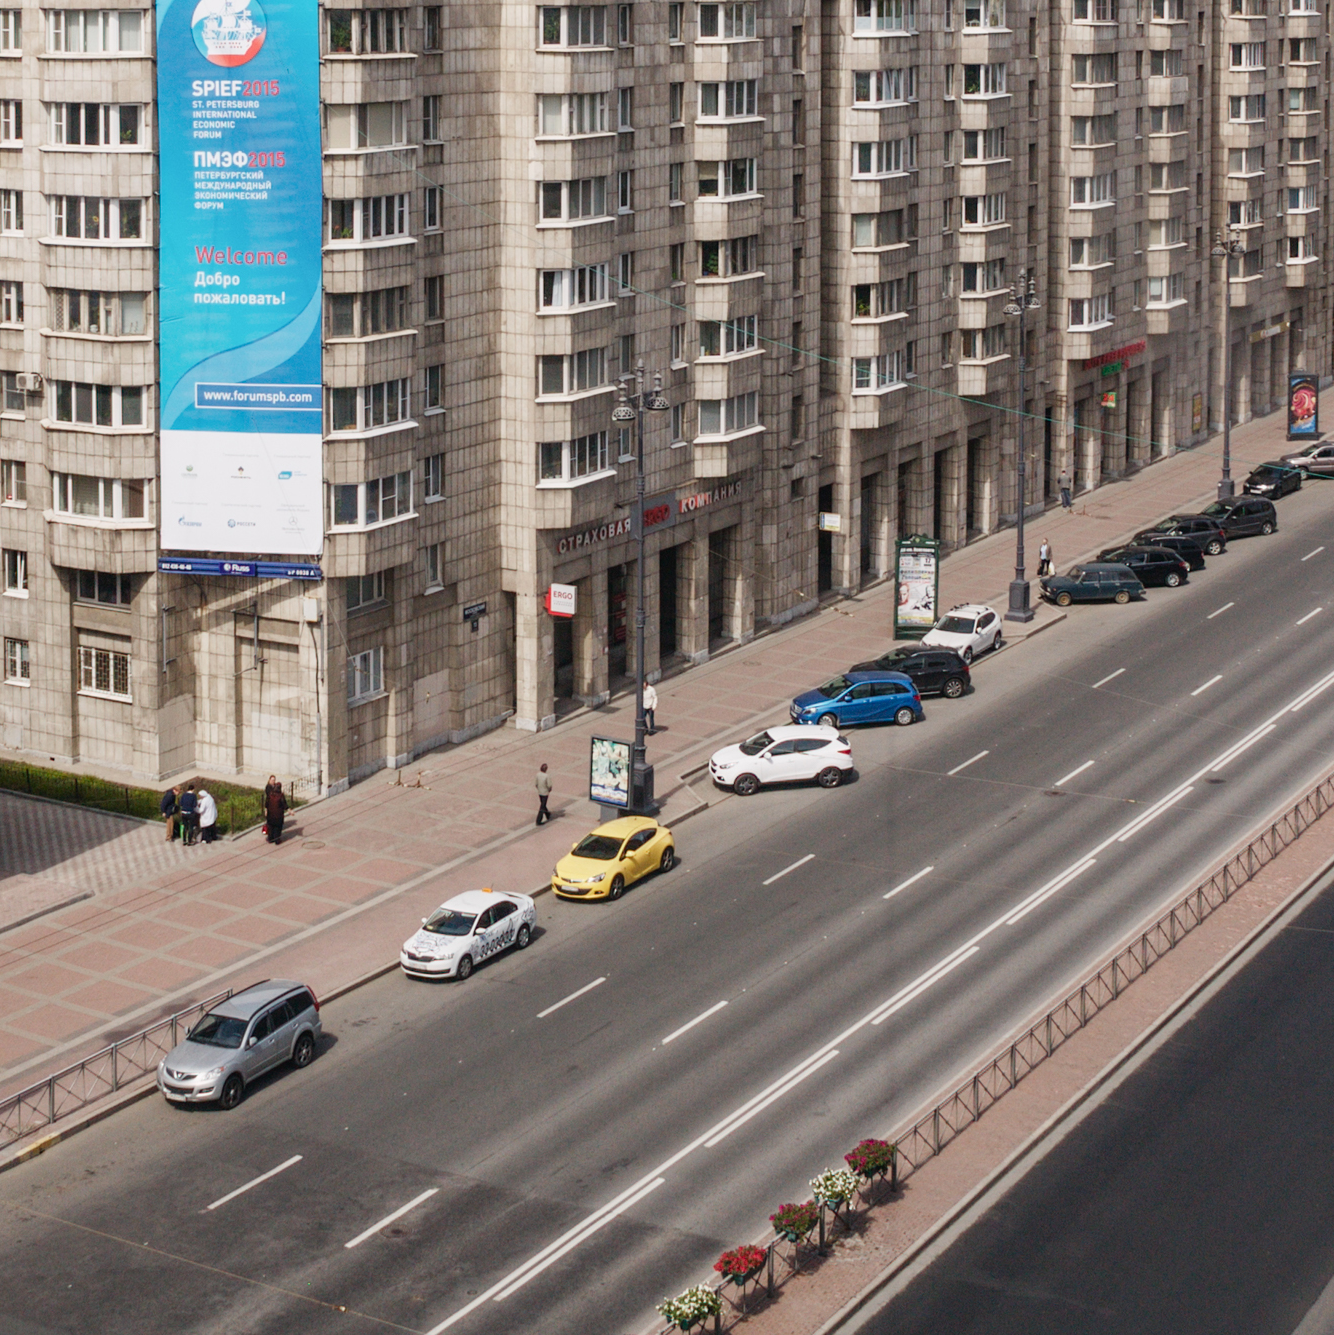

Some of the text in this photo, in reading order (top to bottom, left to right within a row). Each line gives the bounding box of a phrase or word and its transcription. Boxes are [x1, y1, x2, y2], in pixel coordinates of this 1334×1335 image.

[192, 100, 259, 108] ST. PETERSBURG
[193, 110, 257, 119] INTERNATIONAL
[193, 120, 235, 129] ECONOMIC
[193, 131, 222, 139] FORUM
[194, 170, 264, 180] ПЕТЕРБУРГСКИЙ
[194, 180, 272, 190] МЕЖДУНАРОДНЫЙ
[194, 190, 268, 200] ЭКОНОМИЧЕСКИЙ
[194, 201, 224, 210] ФОРУМ
[195, 246, 287, 265] Welcome
[194, 271, 240, 289] Добро
[194, 291, 286, 305] пожаловать!
[204, 390, 312, 404] www.forumspb.com
[557, 518, 631, 554] СТРАХОВАЯ
[679, 481, 742, 513] КОМПАНИЯ
[232, 563, 250, 572] Russ
[553, 590, 573, 601] ERGO
